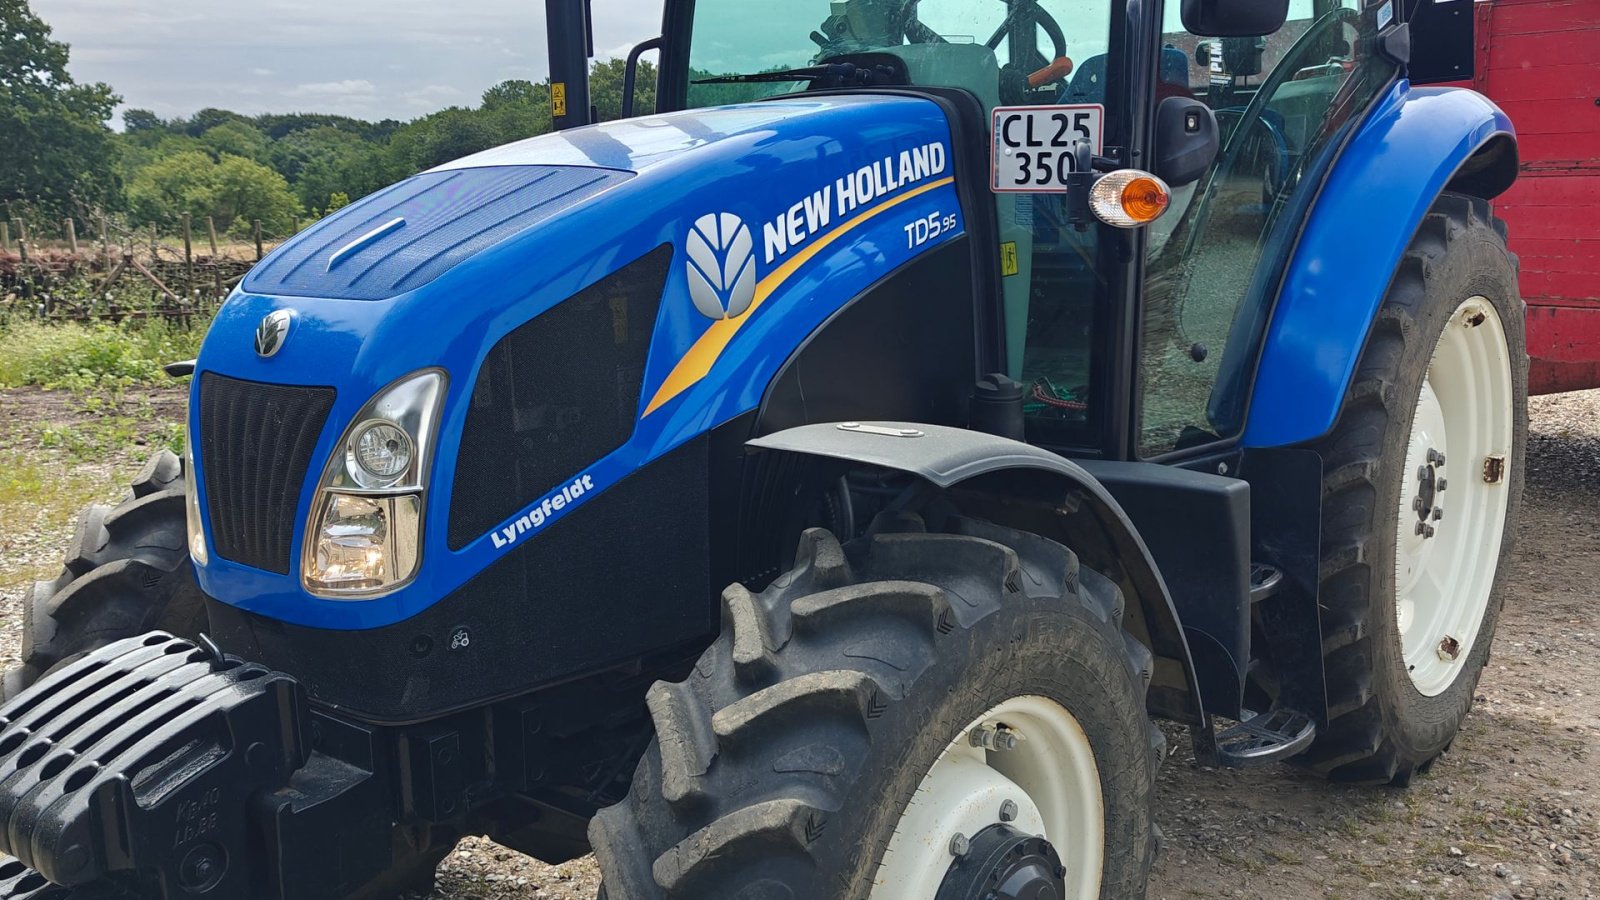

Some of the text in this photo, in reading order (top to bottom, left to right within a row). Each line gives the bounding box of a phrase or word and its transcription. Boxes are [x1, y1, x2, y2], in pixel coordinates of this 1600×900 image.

[1210, 42, 1222, 72] PLM
[1002, 113, 1090, 147] CL 25
[1015, 151, 1076, 185] 350
[763, 141, 945, 265] NEW HOLLAND
[490, 474, 594, 549] Lyngfeldt
